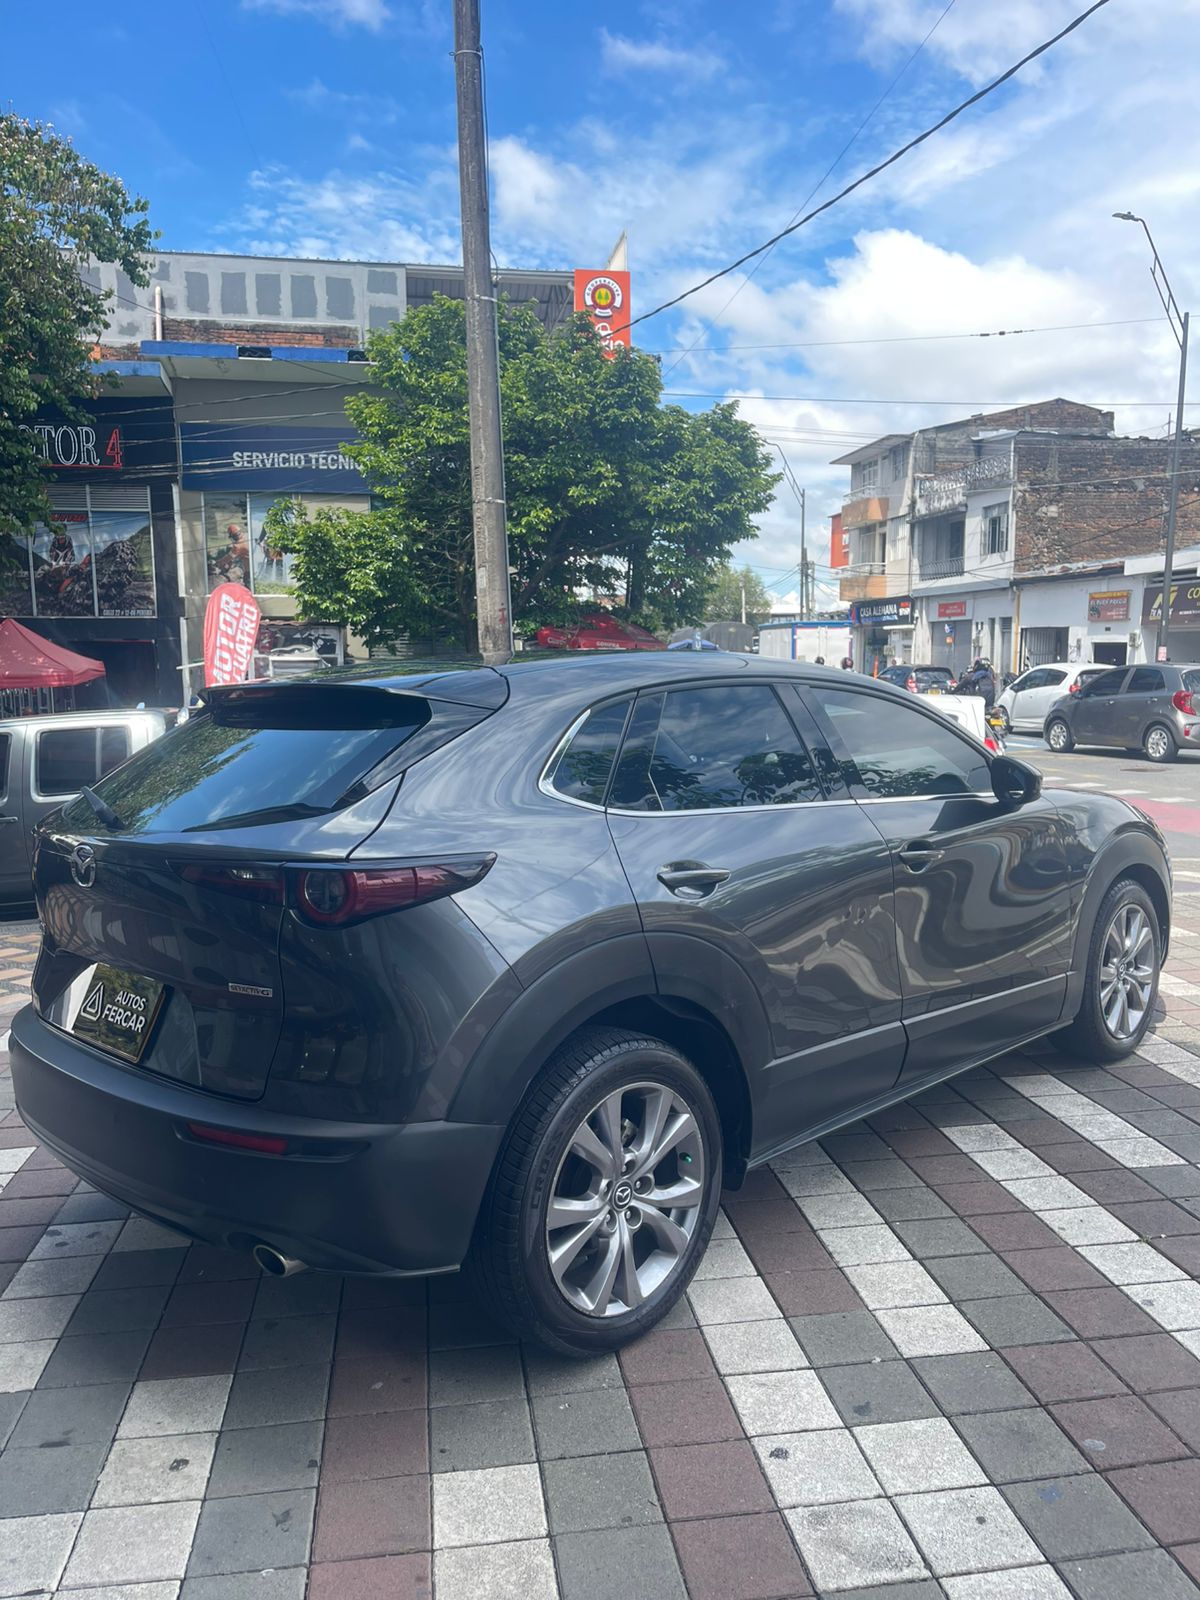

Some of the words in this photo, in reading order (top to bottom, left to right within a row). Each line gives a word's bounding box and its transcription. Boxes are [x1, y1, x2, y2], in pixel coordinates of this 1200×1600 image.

[105, 428, 122, 466] 4
[232, 451, 305, 469] SERVICIO
[114, 990, 146, 1011] AUTOS
[102, 1004, 146, 1033] FERCAR
